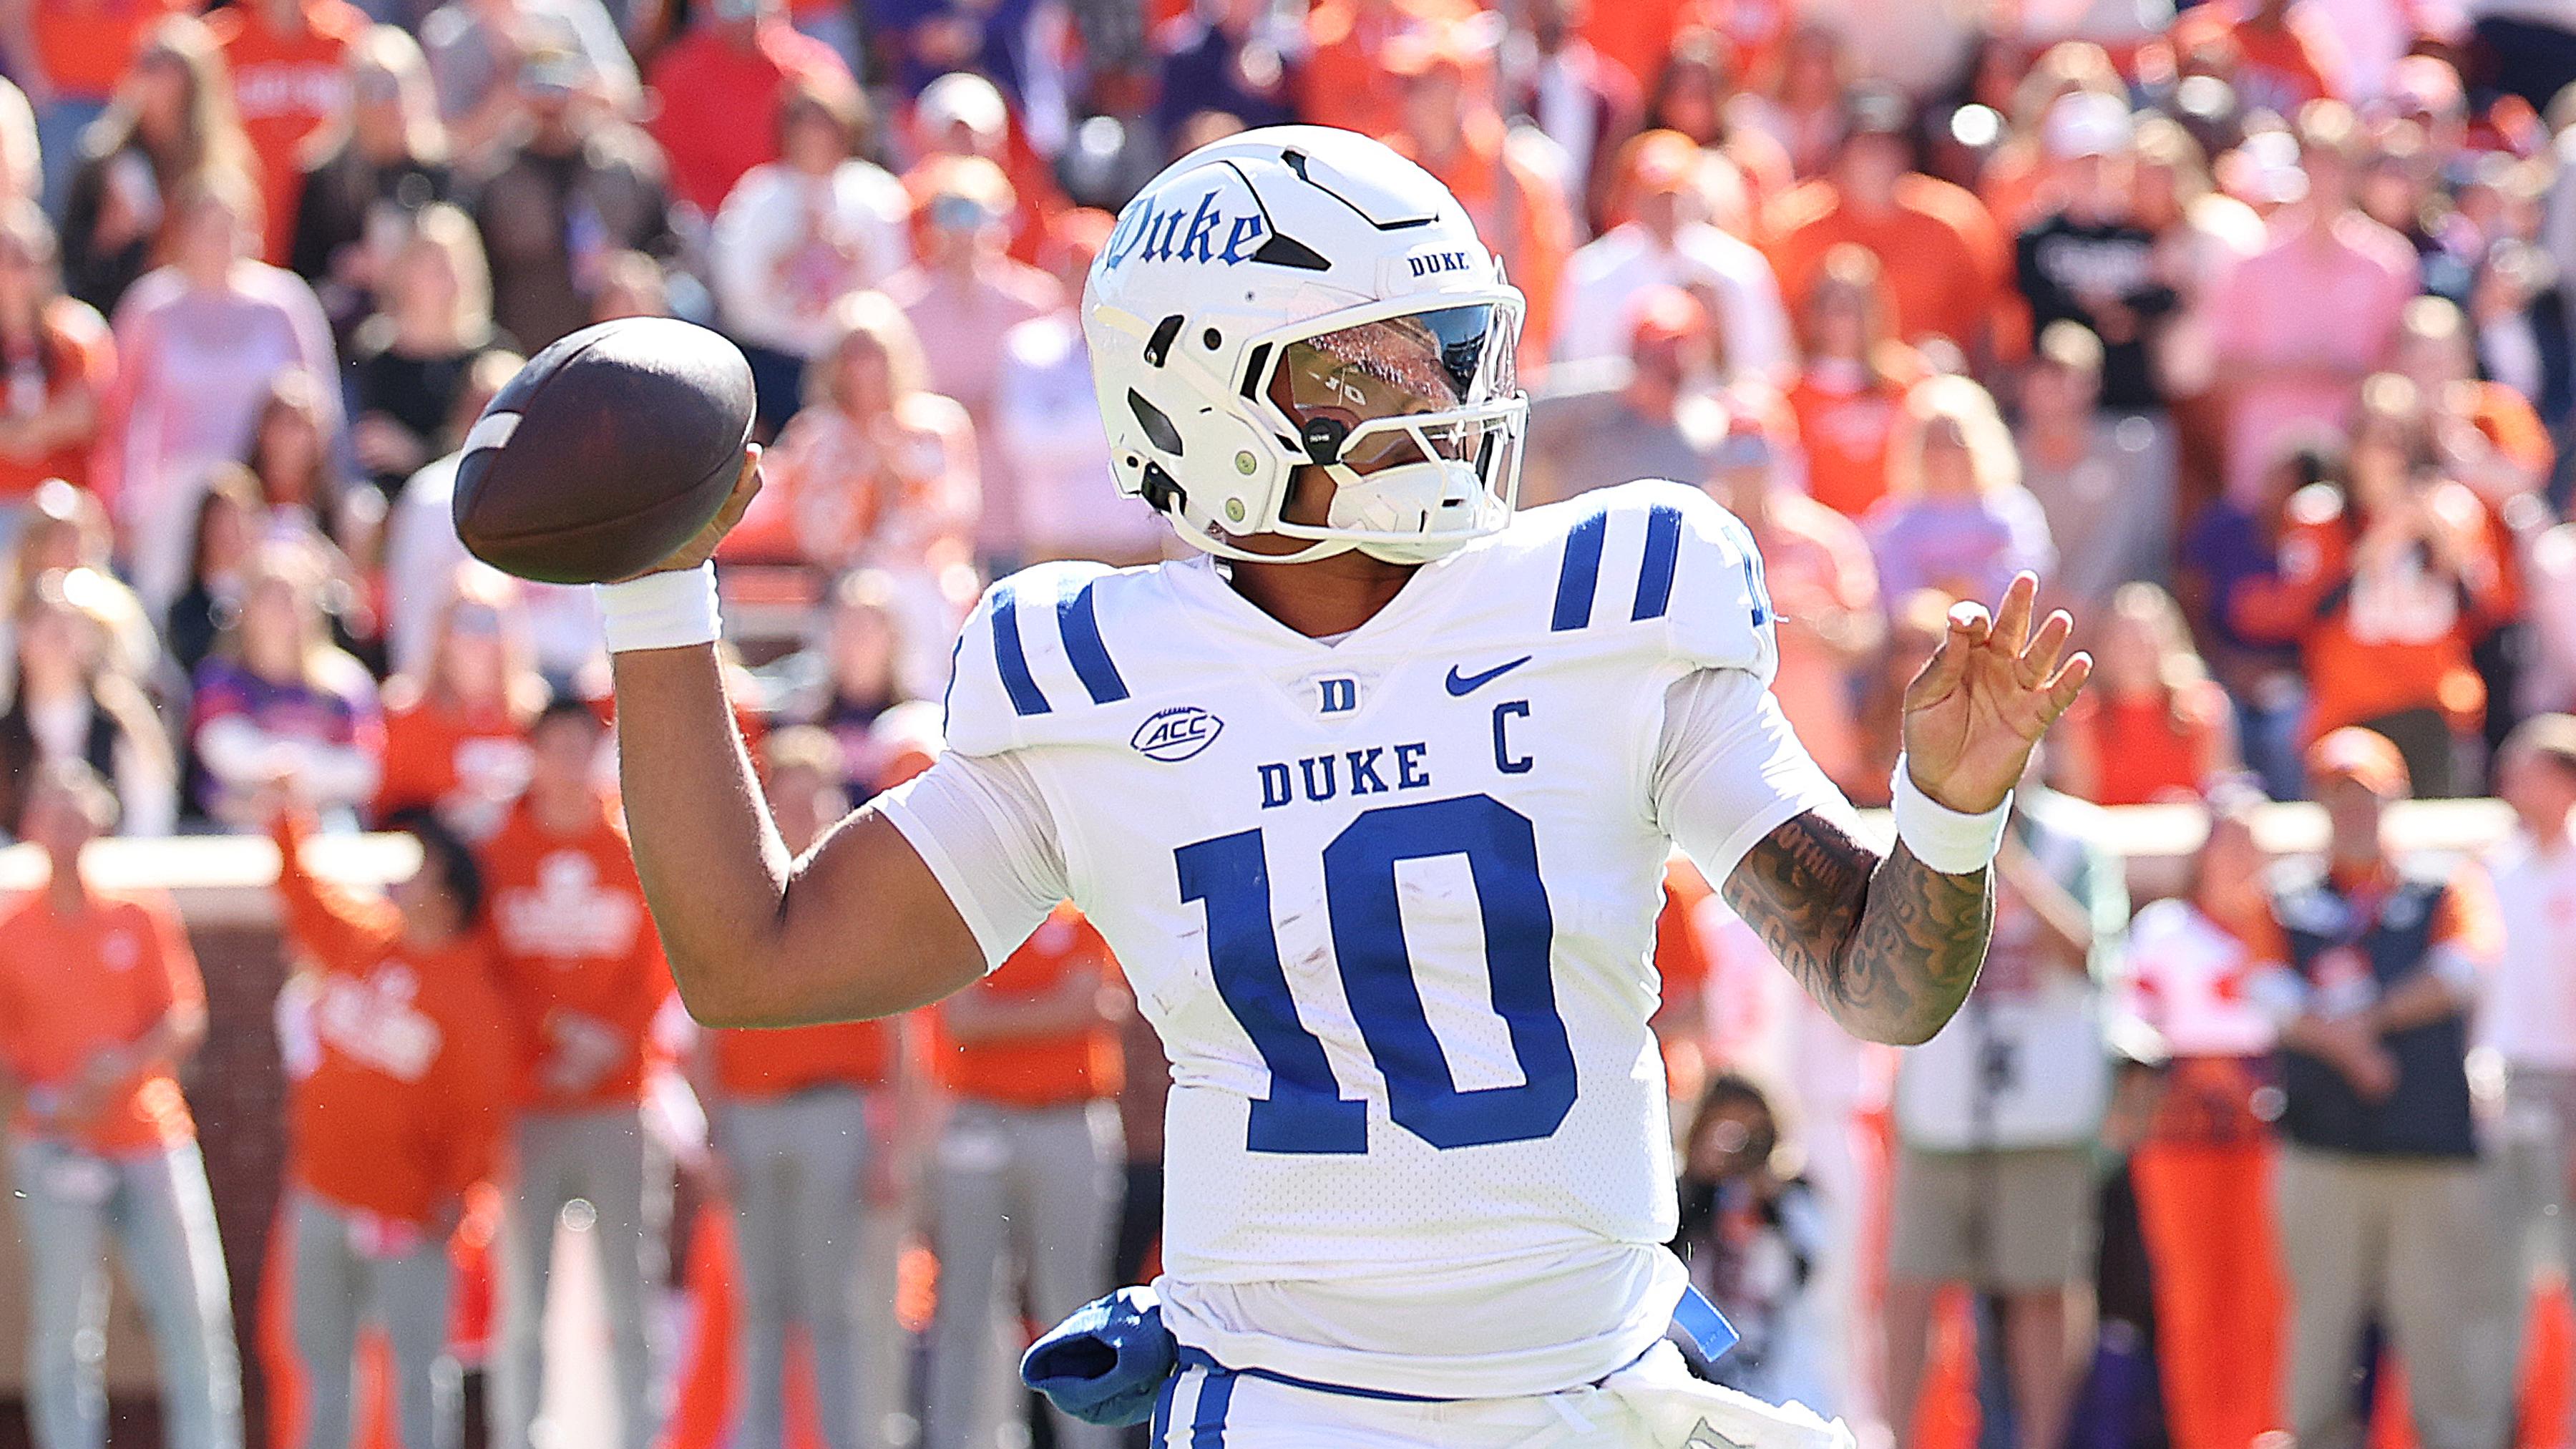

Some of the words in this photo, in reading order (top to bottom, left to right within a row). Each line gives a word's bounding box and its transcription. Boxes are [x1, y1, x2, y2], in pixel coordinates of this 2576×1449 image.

[1097, 187, 1263, 278] Duke
[1407, 252, 1470, 278] DUKE
[1318, 678, 1356, 713] D
[1146, 714, 1209, 746] ACC
[1493, 699, 1533, 774] C
[1257, 742, 1430, 810] DUKE
[1174, 793, 1579, 1155] 10
